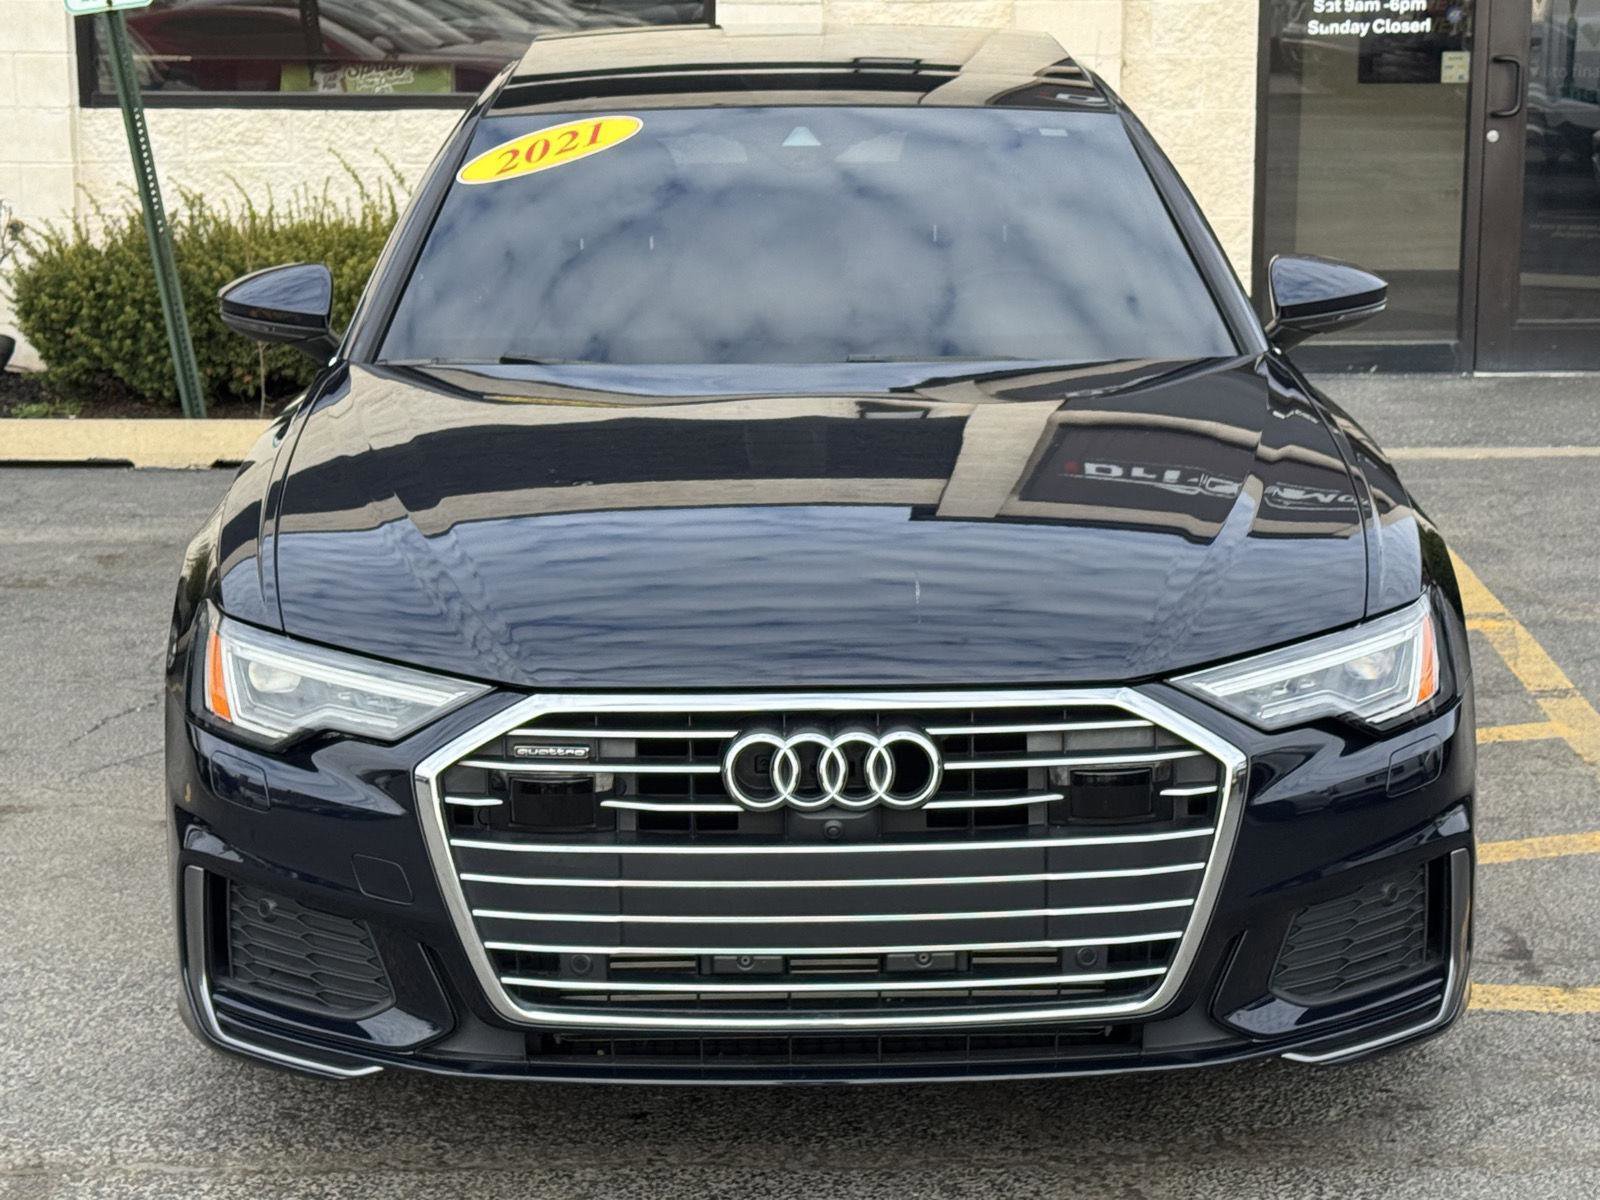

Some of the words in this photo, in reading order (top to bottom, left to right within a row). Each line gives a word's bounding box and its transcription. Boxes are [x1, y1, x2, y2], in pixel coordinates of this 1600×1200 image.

[1313, 0, 1341, 13] Sat
[1344, 0, 1381, 12] 9am
[1307, 19, 1370, 38] Sunday
[1372, 17, 1432, 34] Closed
[495, 122, 603, 176] 2021
[516, 747, 586, 757] quattro
